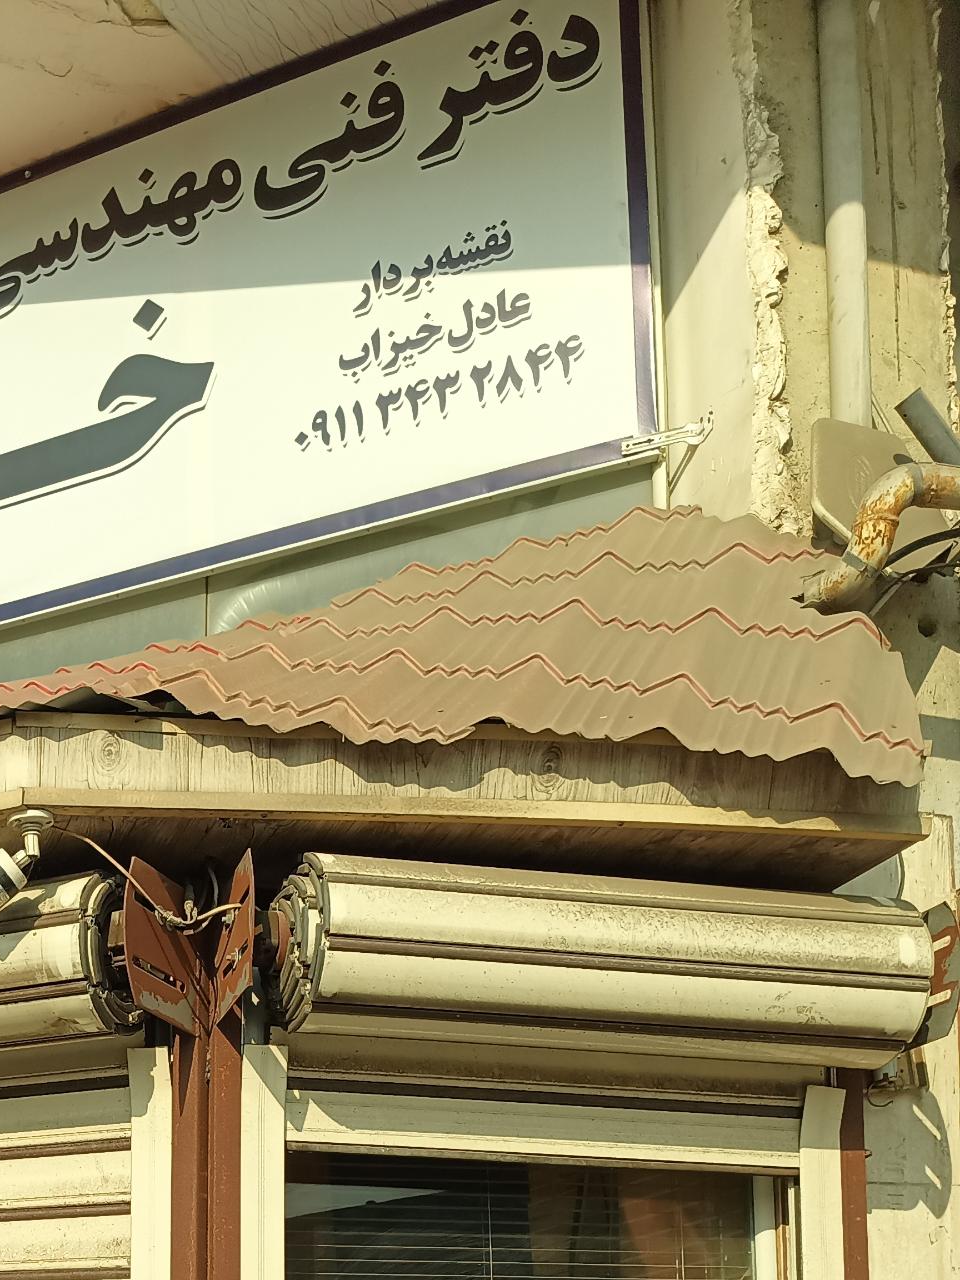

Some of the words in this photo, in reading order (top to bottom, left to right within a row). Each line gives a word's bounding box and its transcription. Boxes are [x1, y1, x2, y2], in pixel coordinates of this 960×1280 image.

[418, 9, 604, 169] دفتر
[254, 59, 406, 219] فنی
[437, 220, 514, 276] نقشه
[353, 257, 434, 317] بردار
[447, 288, 532, 353] عادل
[338, 312, 443, 383] خیزاب
